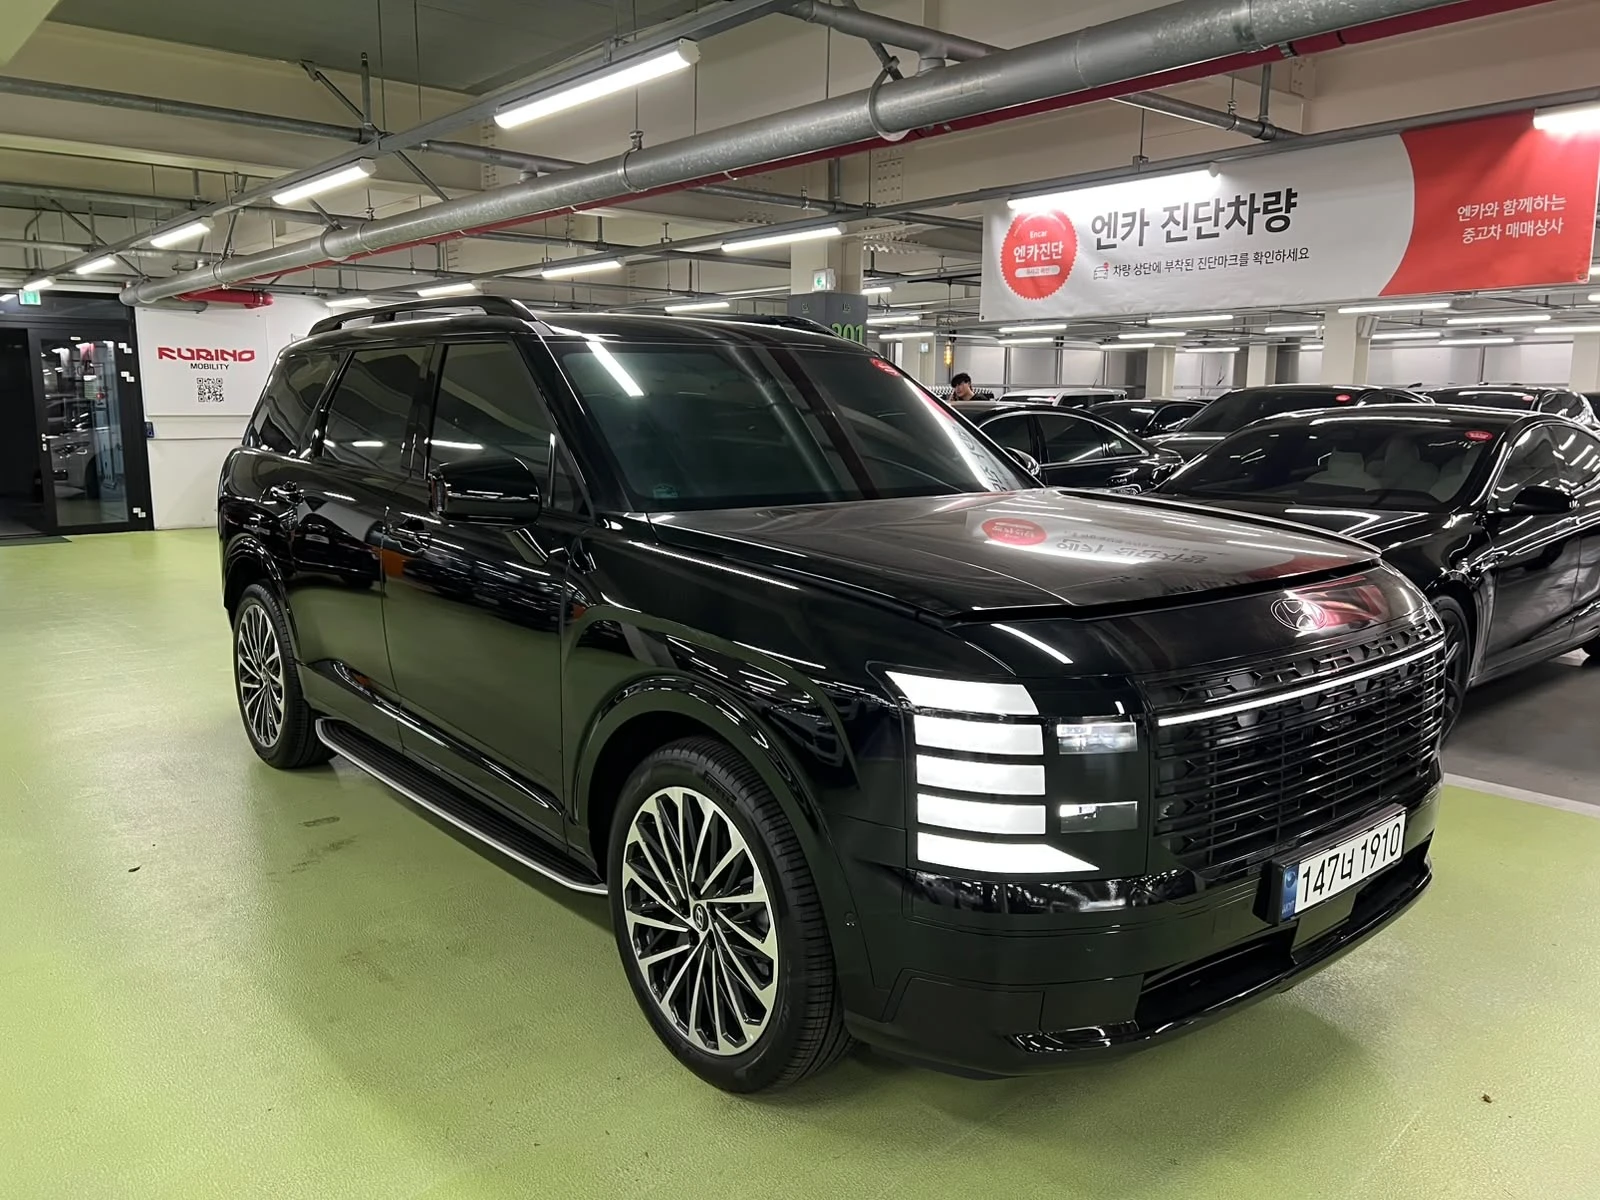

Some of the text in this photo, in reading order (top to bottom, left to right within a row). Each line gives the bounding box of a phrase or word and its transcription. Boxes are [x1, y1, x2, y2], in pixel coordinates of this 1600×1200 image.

[1091, 187, 1298, 251] 엔카 진단차량
[1457, 193, 1567, 222] 엔카와 함께하는
[1029, 230, 1048, 239] Encar
[1462, 217, 1564, 244] 중고차 매매상사
[1013, 240, 1064, 263] 엔카진단
[1113, 247, 1310, 278] 차량 상단에 부착된 진단마크를 확인하세요
[1302, 822, 1401, 903] 147너 1910
